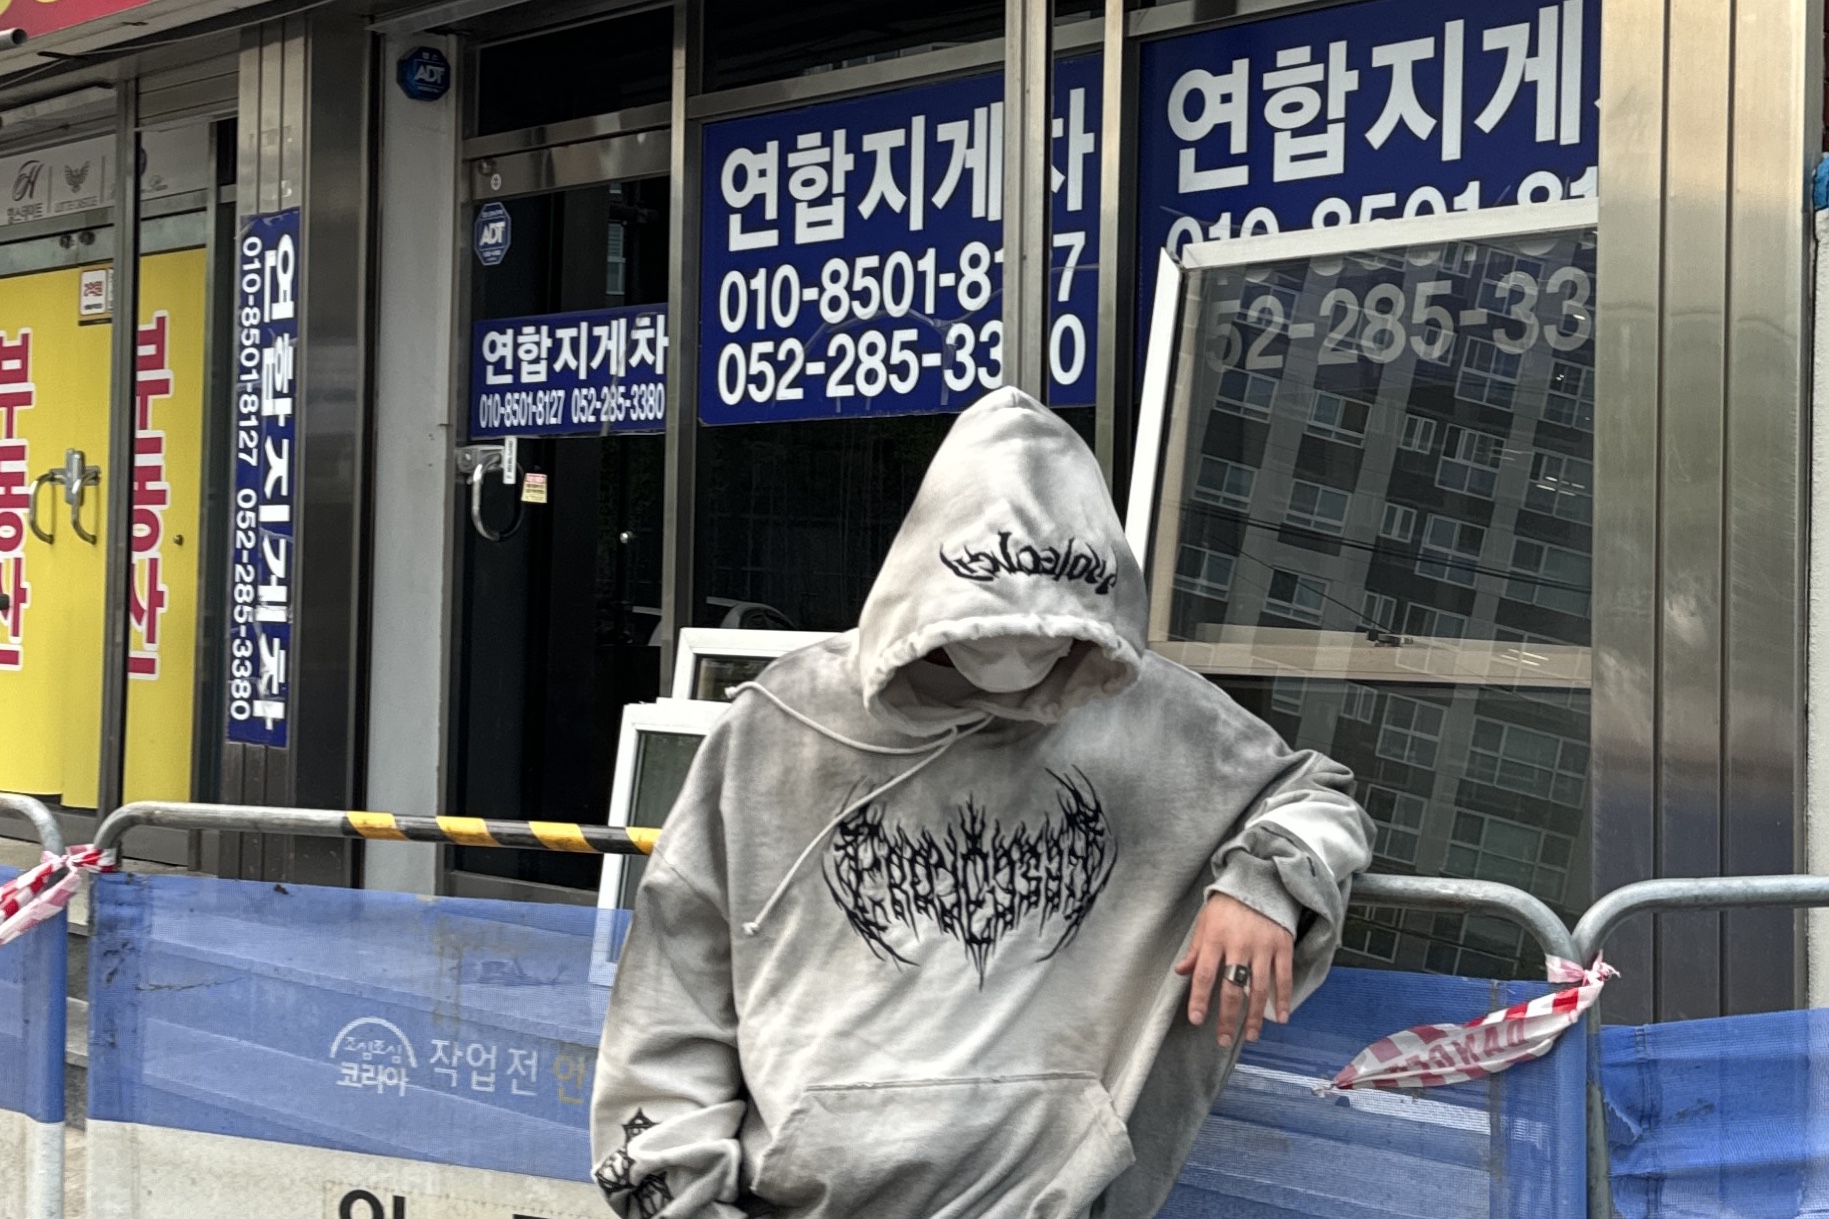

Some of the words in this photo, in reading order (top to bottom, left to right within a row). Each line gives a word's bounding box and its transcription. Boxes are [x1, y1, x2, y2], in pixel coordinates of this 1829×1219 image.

[414, 65, 445, 84] ADT
[1168, 0, 1599, 194] 연합지게
[479, 221, 506, 246] ADT
[719, 231, 1086, 333] 010-8501-87
[238, 236, 263, 467] 010-8501-8127
[482, 314, 669, 385] 연합지게차
[717, 313, 1086, 406] 052-285-330
[479, 389, 566, 428] 010-8501-8127
[571, 382, 665, 424] 052-285-3380
[253, 233, 295, 731] 연합지게차
[230, 488, 258, 720] 052-285-3380
[336, 1061, 410, 1097] 코리아
